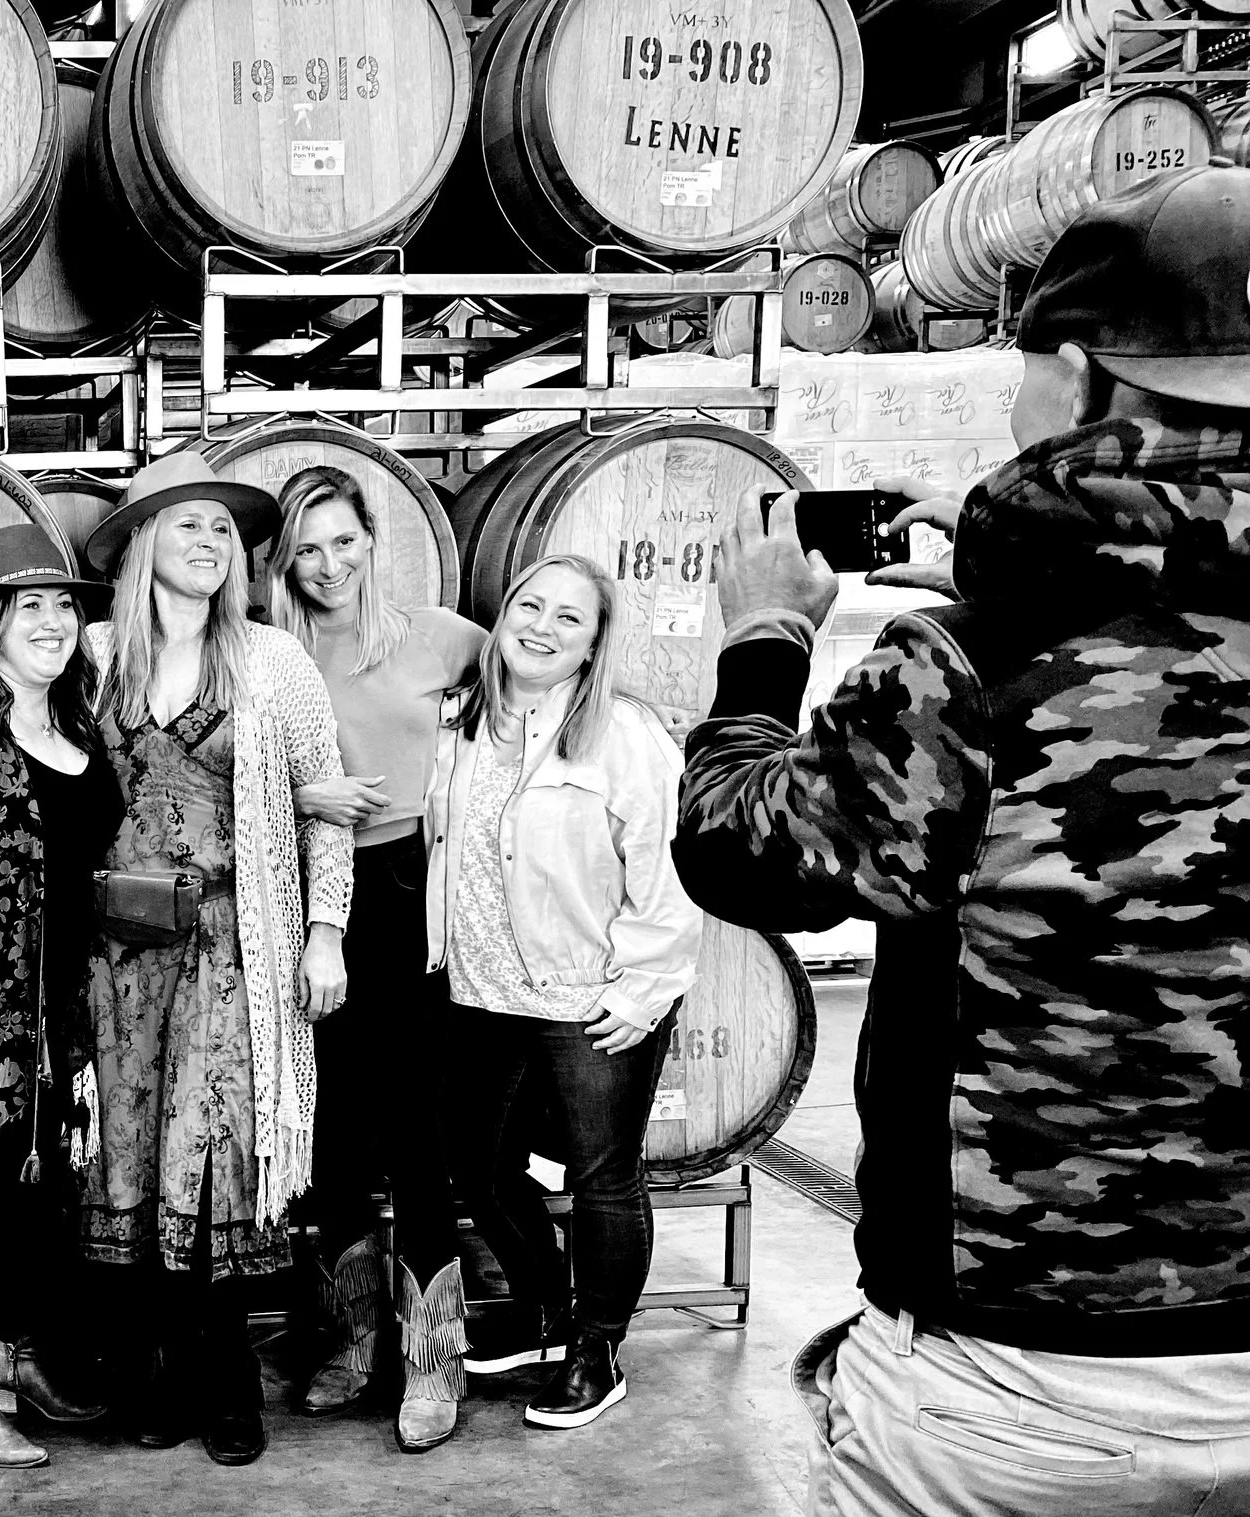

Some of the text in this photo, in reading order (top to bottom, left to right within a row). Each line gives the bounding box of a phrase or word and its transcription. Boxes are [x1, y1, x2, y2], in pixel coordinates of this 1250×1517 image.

[711, 15, 733, 29] 3Y
[622, 35, 772, 85] 19-908
[232, 55, 380, 104] 19-913
[624, 105, 742, 158] LENNE
[1116, 148, 1185, 172] 19-252
[799, 290, 849, 306] 19-028
[766, 451, 797, 479] 18-810
[617, 540, 720, 583] 18-81
